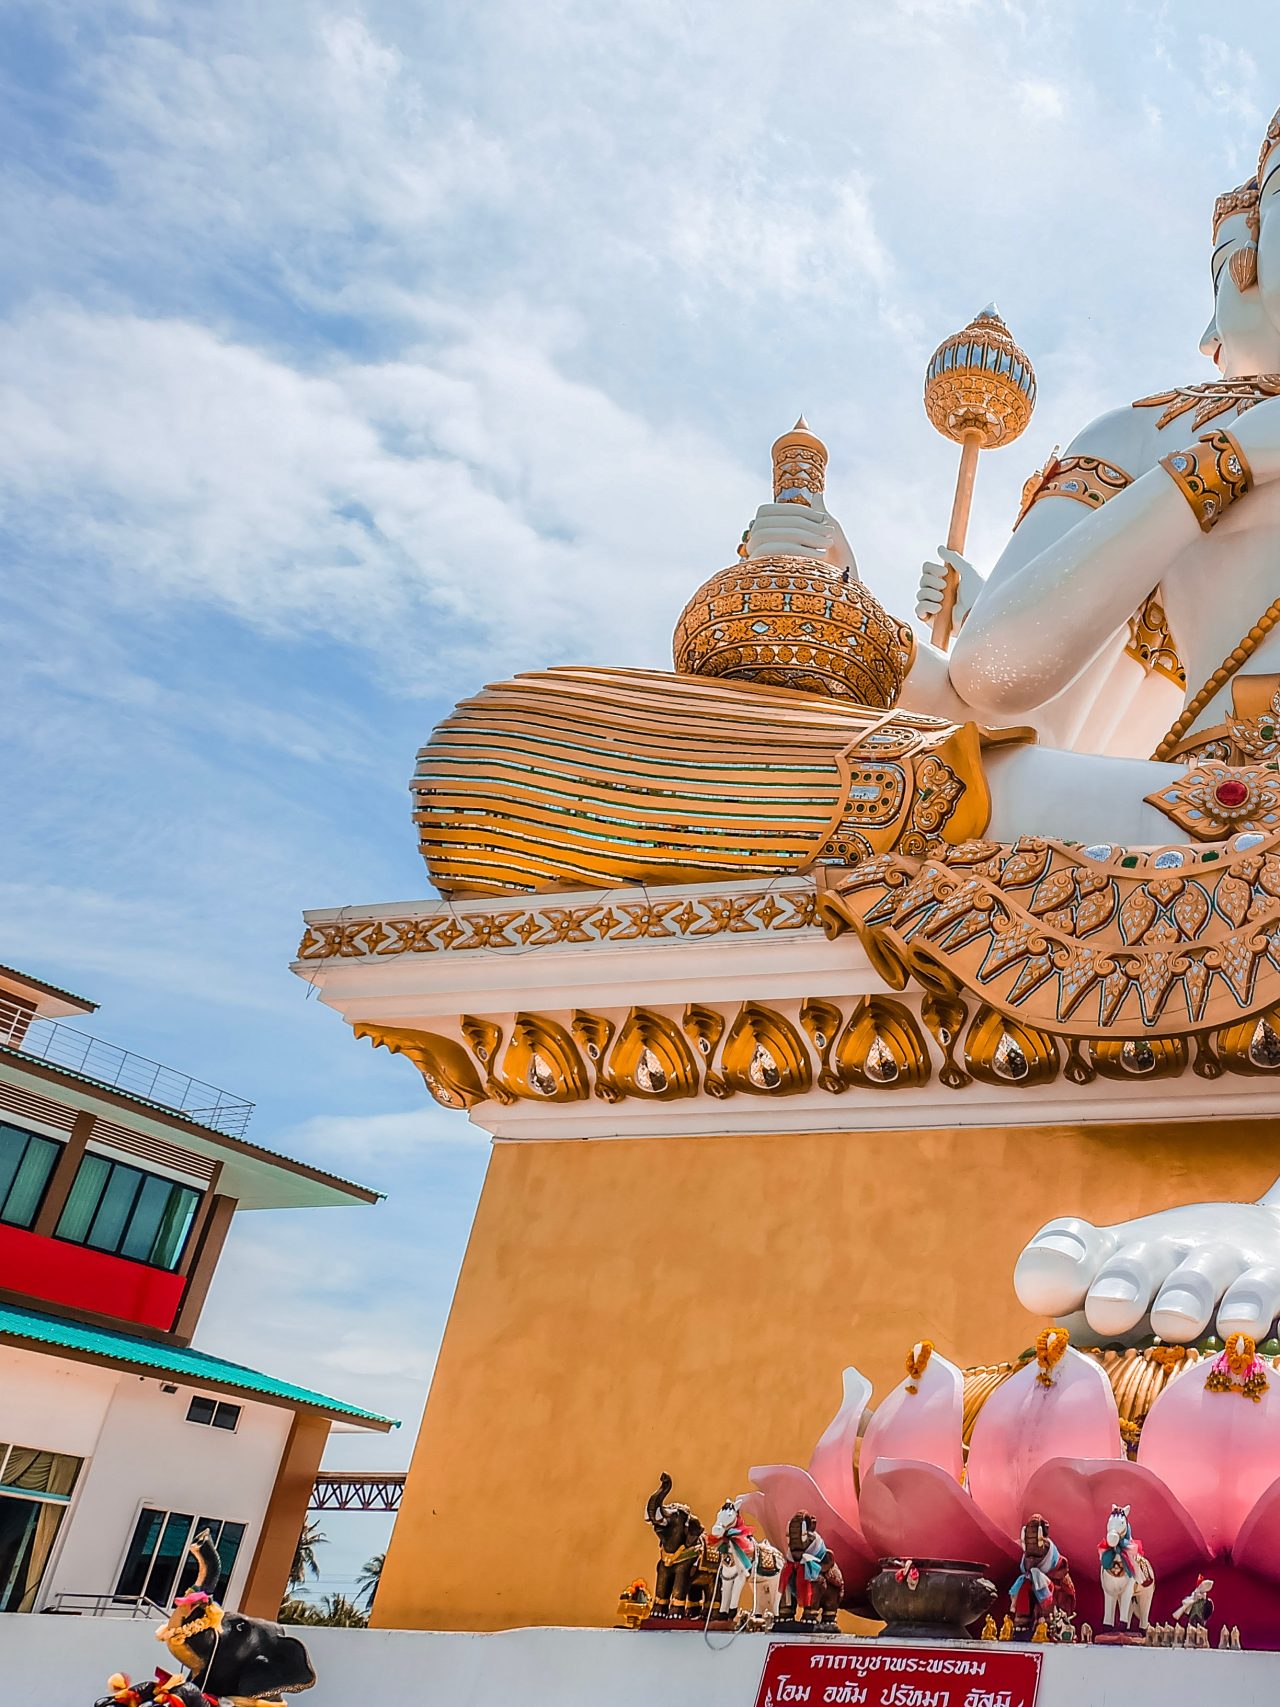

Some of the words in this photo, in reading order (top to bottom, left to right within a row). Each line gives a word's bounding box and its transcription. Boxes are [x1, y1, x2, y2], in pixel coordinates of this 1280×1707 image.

[810, 1654, 986, 1677] คาถาบูชาพระพรหม
[776, 1674, 812, 1702] โอม
[823, 1680, 868, 1704] อหัม
